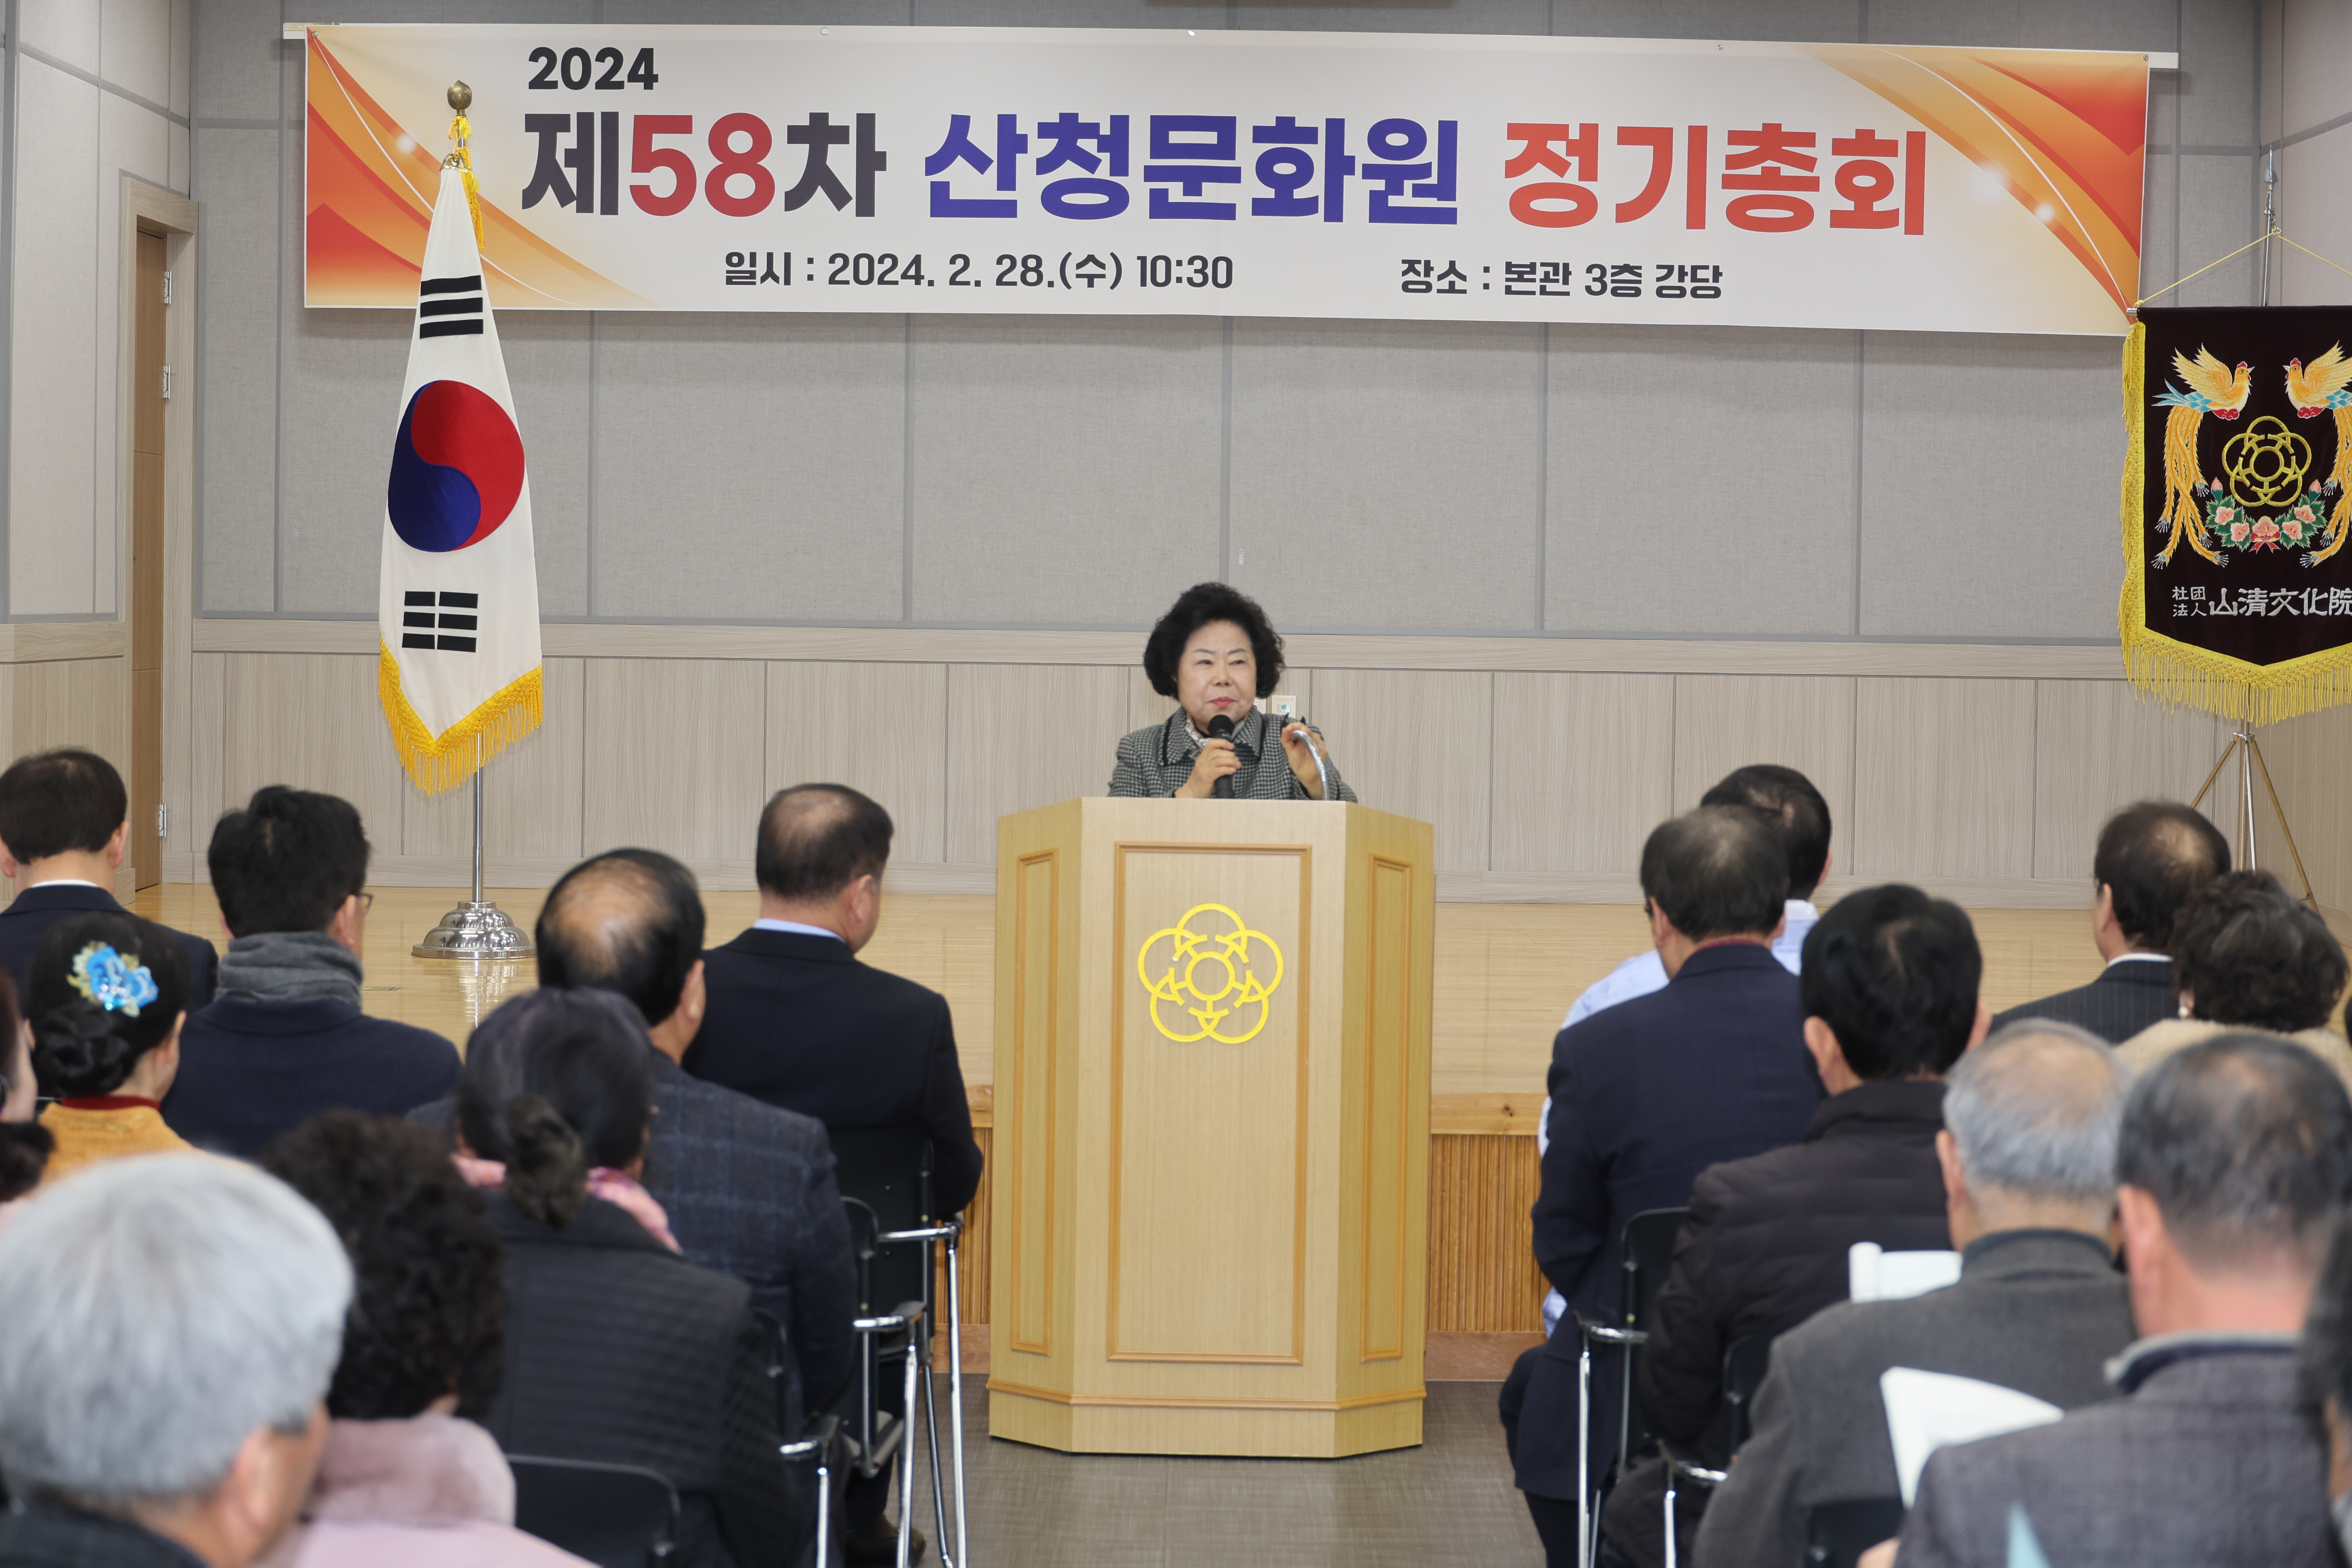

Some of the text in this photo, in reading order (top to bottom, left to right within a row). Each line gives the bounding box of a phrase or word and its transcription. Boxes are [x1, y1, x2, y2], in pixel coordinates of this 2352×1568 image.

[528, 46, 659, 91] 2024
[521, 111, 1927, 236] 제58차 산청문화원 정기총회
[725, 251, 791, 286] 일시
[828, 252, 935, 287] 2024.
[949, 253, 982, 287] 2.
[995, 251, 1123, 290] 28.(수)
[1136, 255, 1233, 289] 10:30
[1401, 259, 1468, 294] 장소
[1504, 261, 1572, 297] 본관
[1584, 263, 1642, 298] 3층
[1655, 264, 1723, 299] 강당
[2172, 603, 2207, 617] 法人
[2208, 587, 2352, 617] 山清文化院
